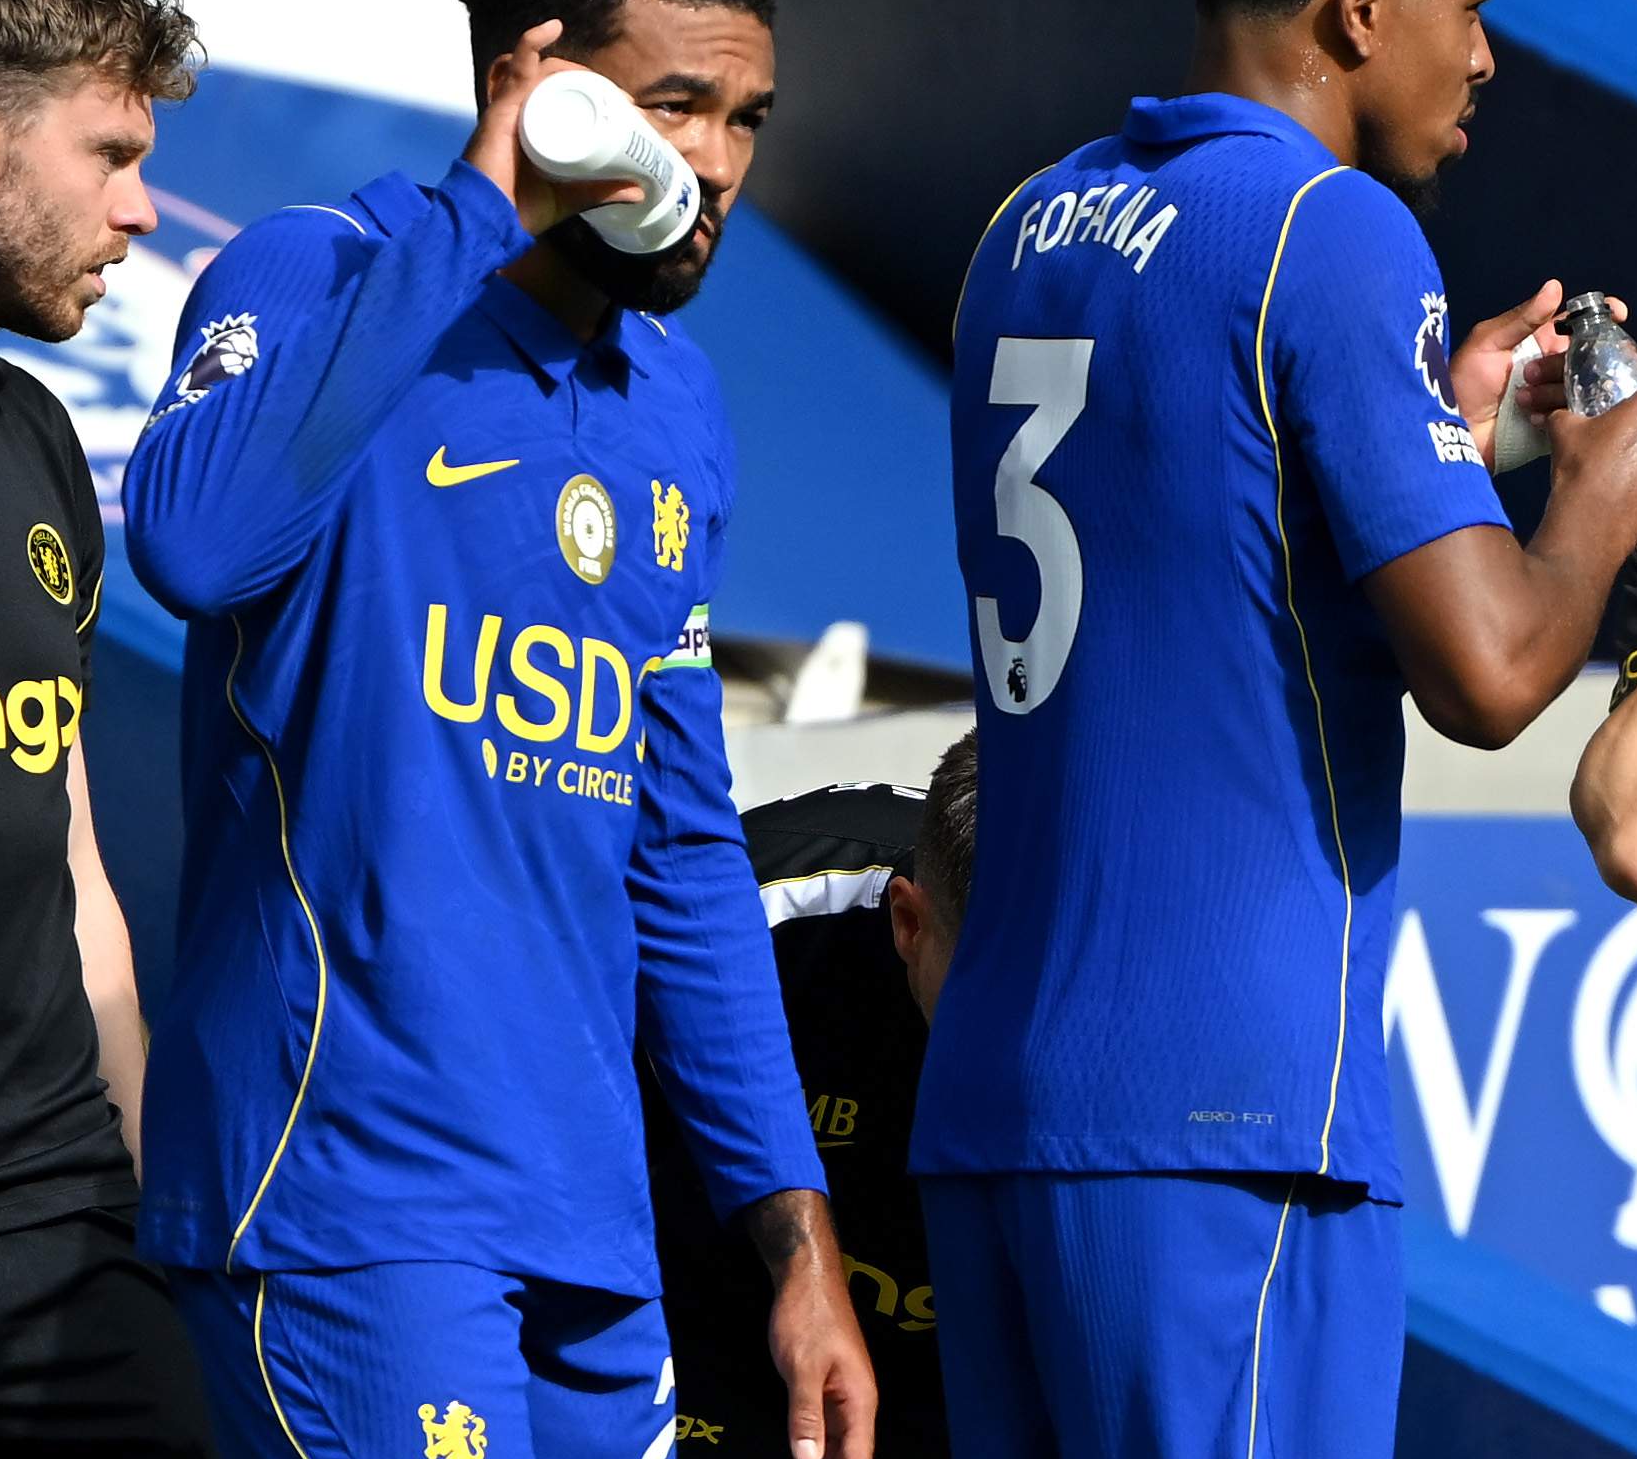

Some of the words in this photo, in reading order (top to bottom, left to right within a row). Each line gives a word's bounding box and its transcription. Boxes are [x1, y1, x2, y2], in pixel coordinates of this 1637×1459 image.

[1011, 182, 1180, 274] FOFANA
[975, 336, 1095, 715] 3
[423, 603, 663, 764] USD
[505, 751, 552, 787] BY
[557, 761, 634, 806] CIRCLE
